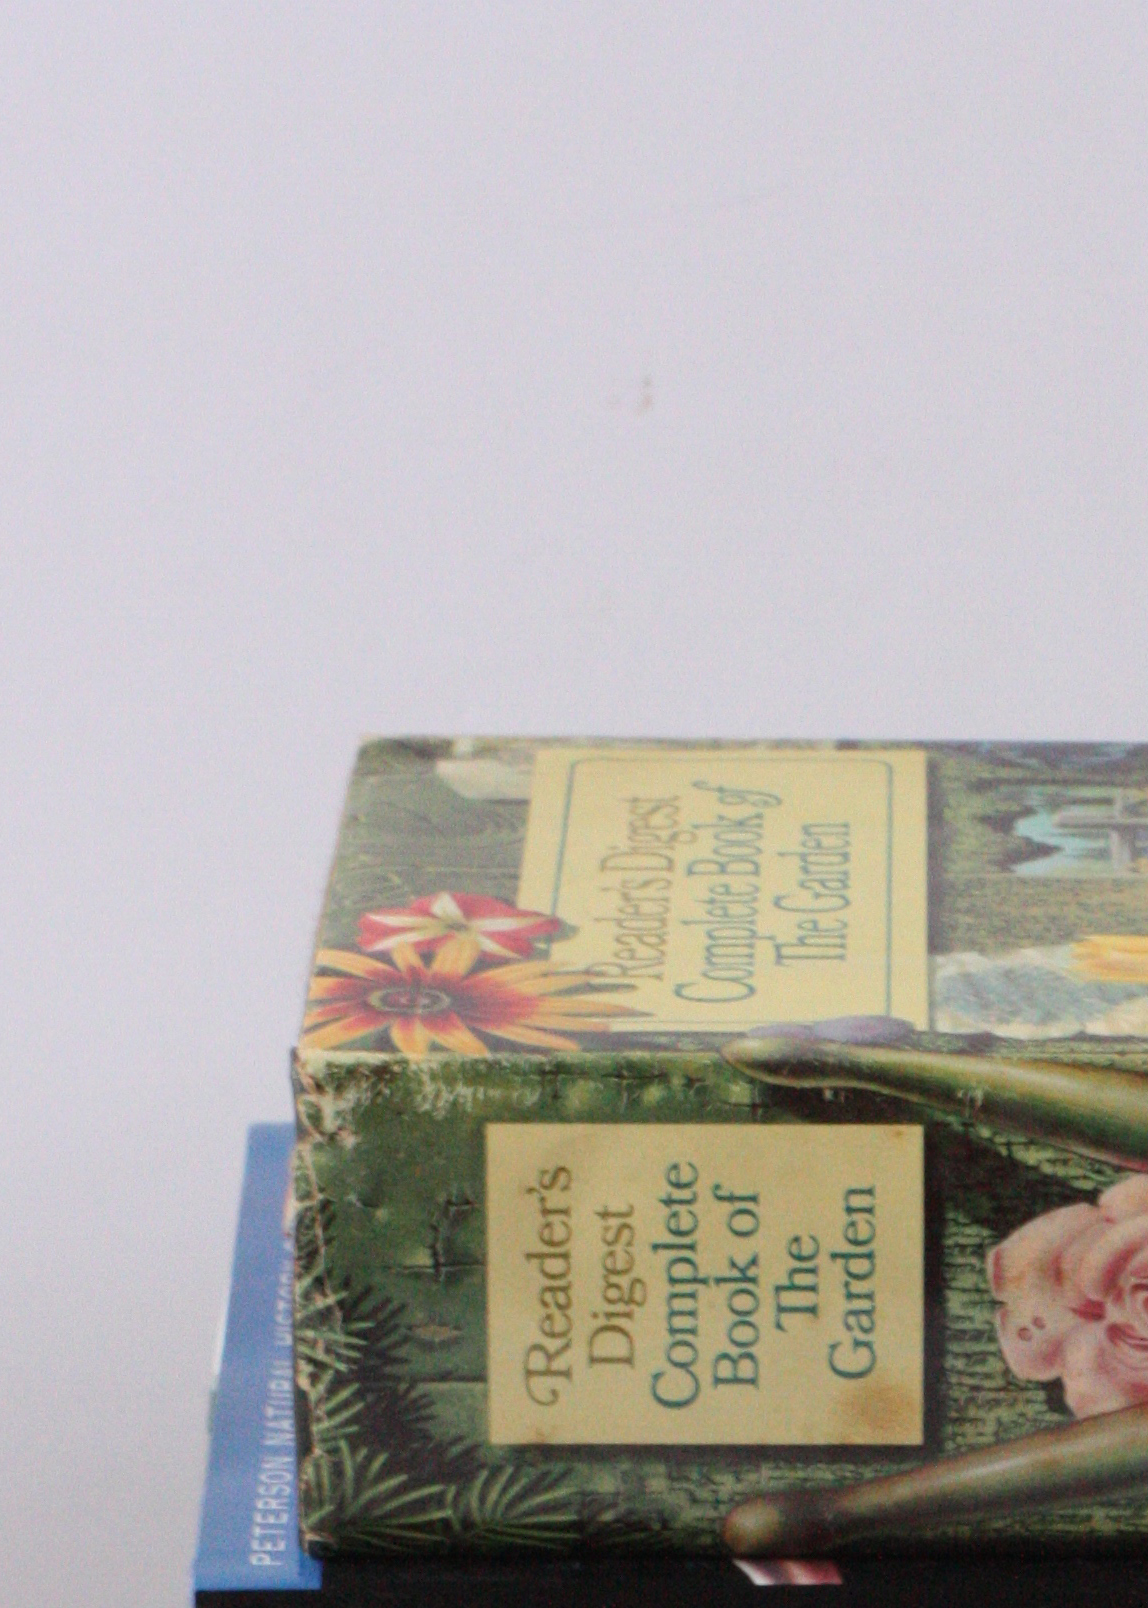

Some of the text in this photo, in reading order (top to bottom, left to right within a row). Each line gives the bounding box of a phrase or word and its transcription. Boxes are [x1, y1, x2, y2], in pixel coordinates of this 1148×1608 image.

[586, 794, 697, 985] Reader's Digest
[673, 779, 783, 1003] Complete Book of
[773, 821, 851, 967] The Garden
[523, 1165, 573, 1407] Reader's
[588, 1204, 647, 1369] Digest
[651, 1161, 710, 1411] Complete
[712, 1183, 761, 1390] Book of
[774, 1234, 820, 1333] The
[828, 1185, 876, 1380] Garden
[249, 1457, 296, 1567] PETERSON
